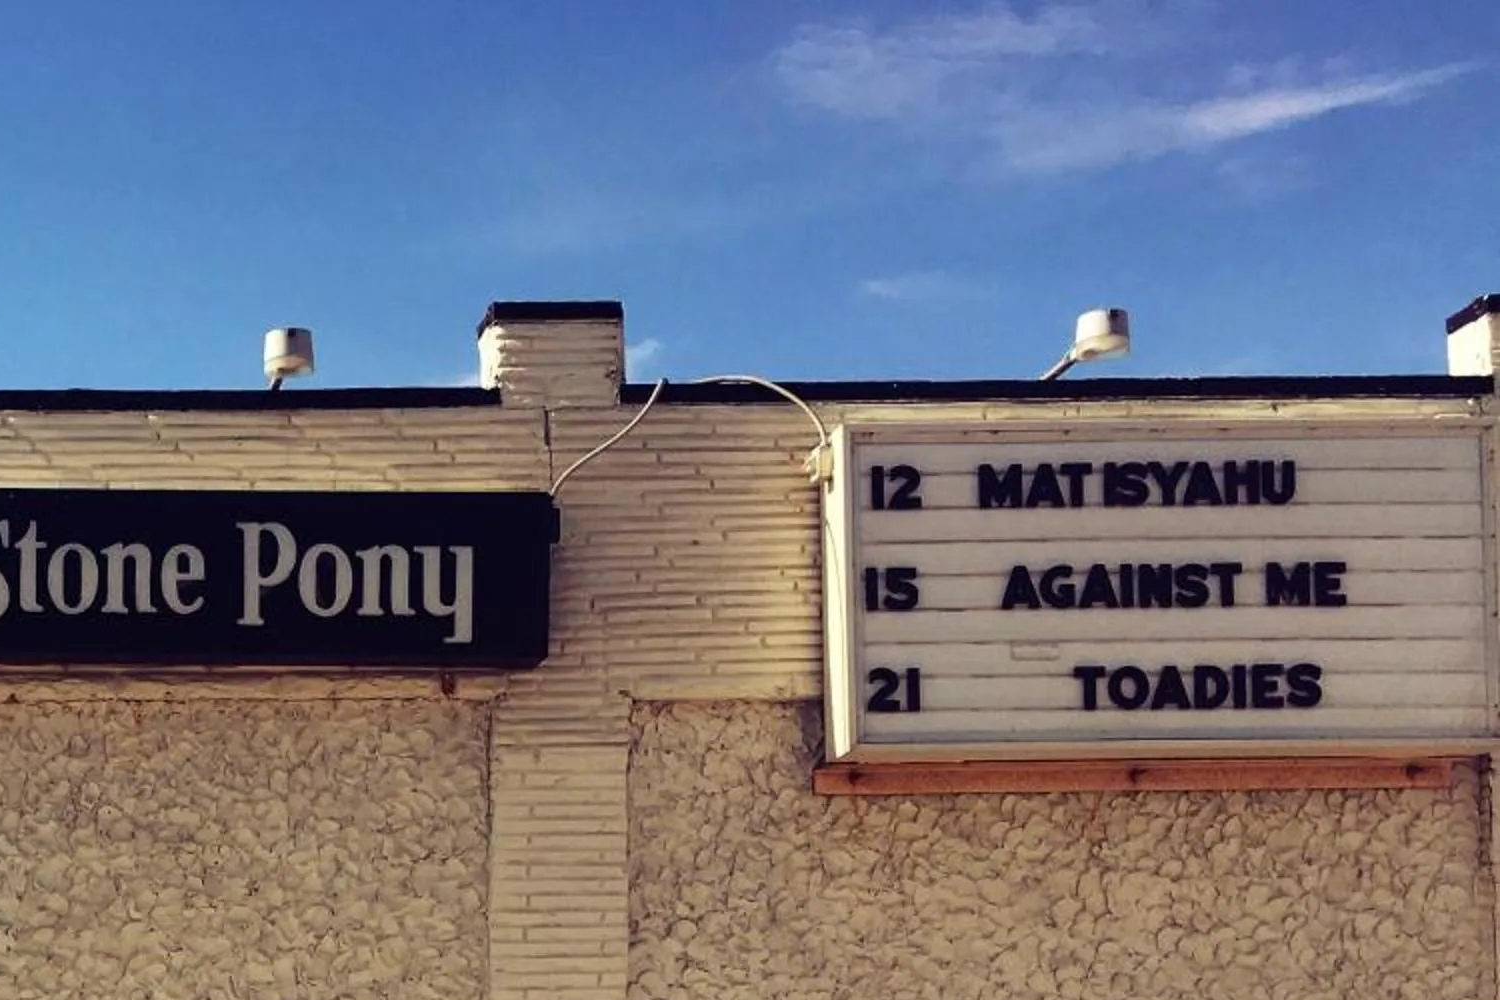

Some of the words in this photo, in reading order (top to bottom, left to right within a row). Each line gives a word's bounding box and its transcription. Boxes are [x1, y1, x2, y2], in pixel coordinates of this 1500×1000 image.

[869, 464, 922, 511] 12
[977, 460, 1297, 510] MATISYAHU
[235, 521, 474, 644] Pony
[863, 566, 919, 613] 15
[999, 562, 1244, 611] AGAINST
[1263, 561, 1348, 608] ME
[866, 667, 922, 714] 21
[1073, 663, 1323, 712] TOADIES
